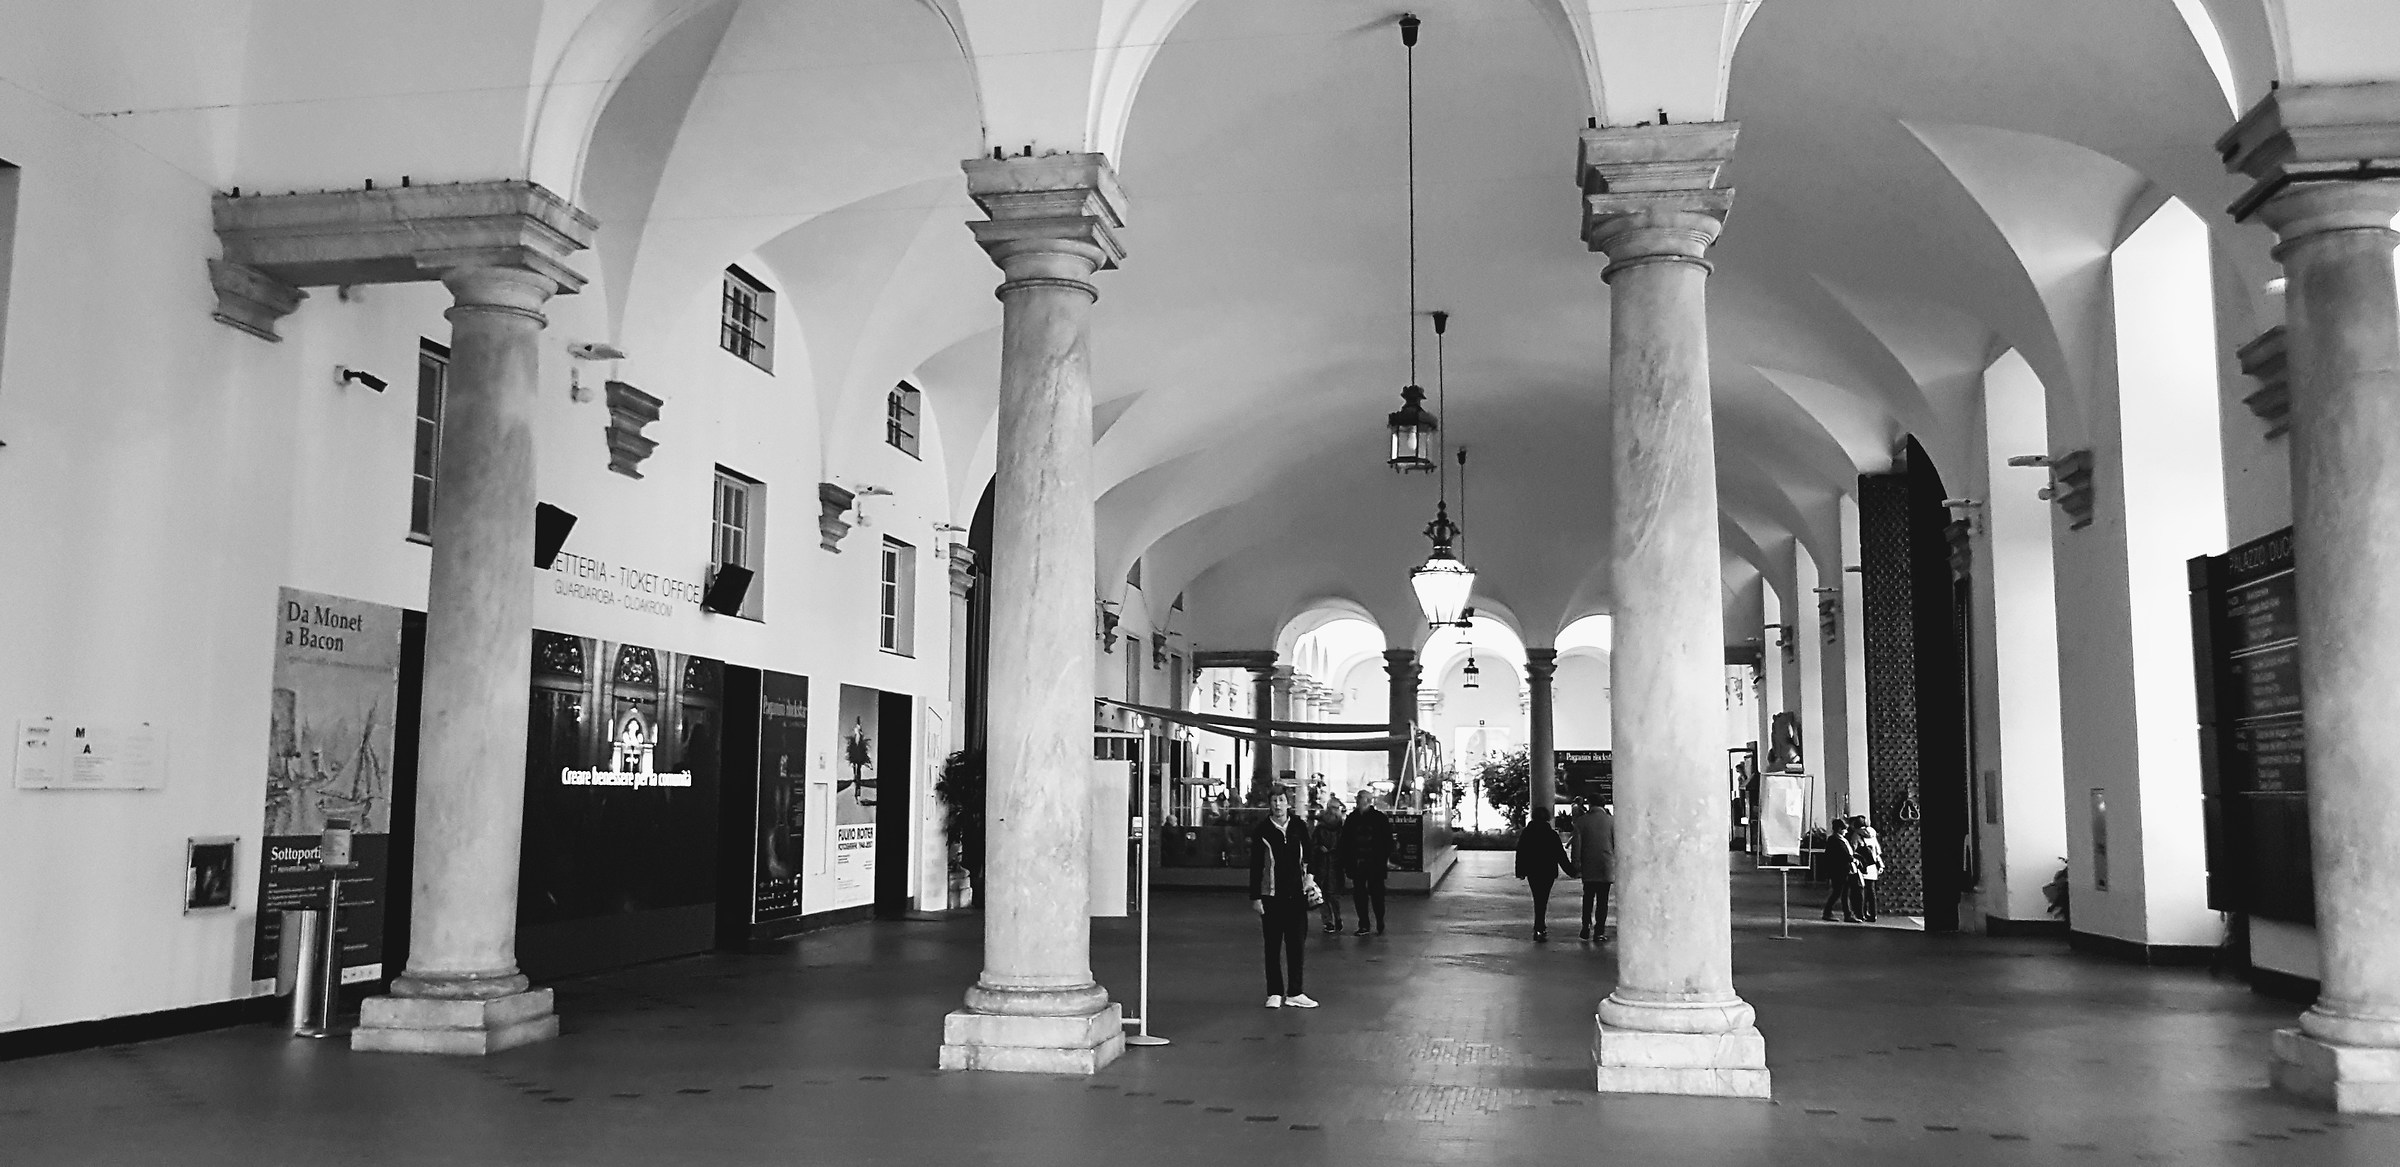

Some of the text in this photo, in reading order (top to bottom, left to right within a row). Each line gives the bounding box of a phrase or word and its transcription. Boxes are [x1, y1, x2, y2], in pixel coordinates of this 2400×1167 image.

[551, 551, 607, 582] ETTERIA
[620, 566, 659, 594] TICKET
[662, 578, 700, 604] OFFICE
[554, 579, 615, 605] GUARDAROBA
[624, 595, 673, 617] CLOAKROOM
[288, 601, 363, 632] Da Monet
[285, 627, 344, 651] a Bacon
[75, 727, 86, 738] M
[83, 744, 91, 754] A
[562, 767, 591, 786] Creare
[591, 765, 634, 786] benessere
[634, 772, 648, 790] per
[271, 845, 321, 866] Sottoporti
